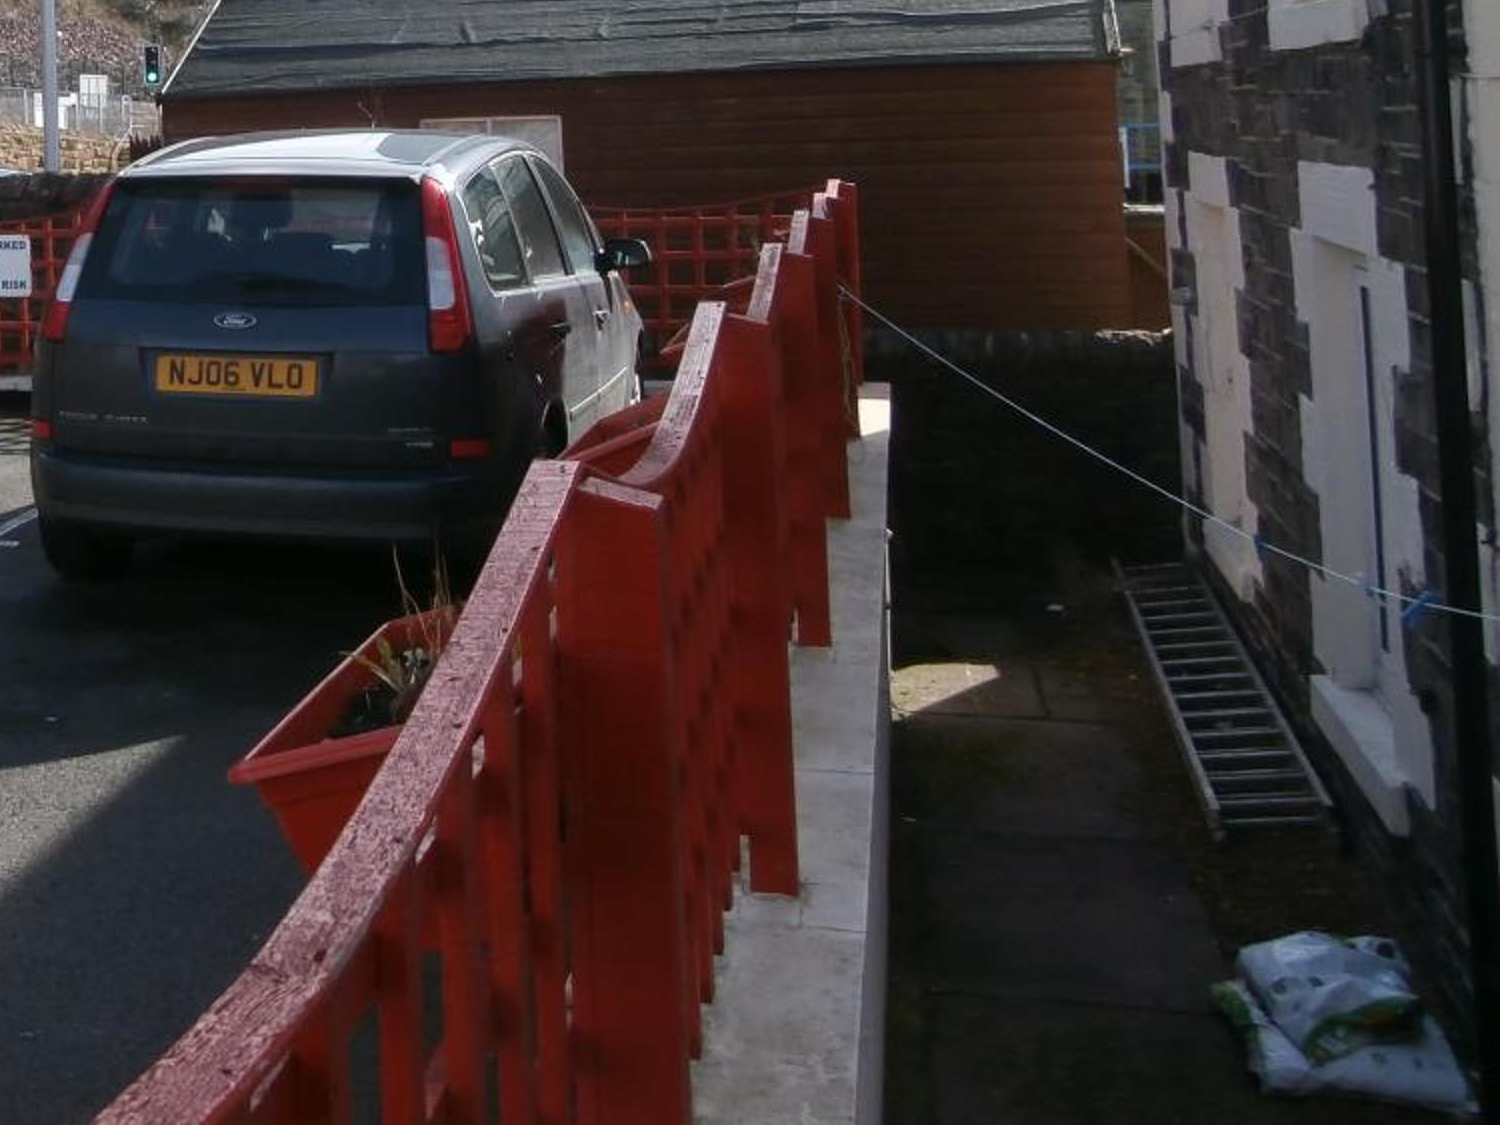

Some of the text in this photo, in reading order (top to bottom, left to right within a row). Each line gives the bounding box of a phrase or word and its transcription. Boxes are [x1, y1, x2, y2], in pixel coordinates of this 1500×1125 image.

[1, 279, 27, 290] RISK
[167, 362, 304, 390] NJ06 VLO
